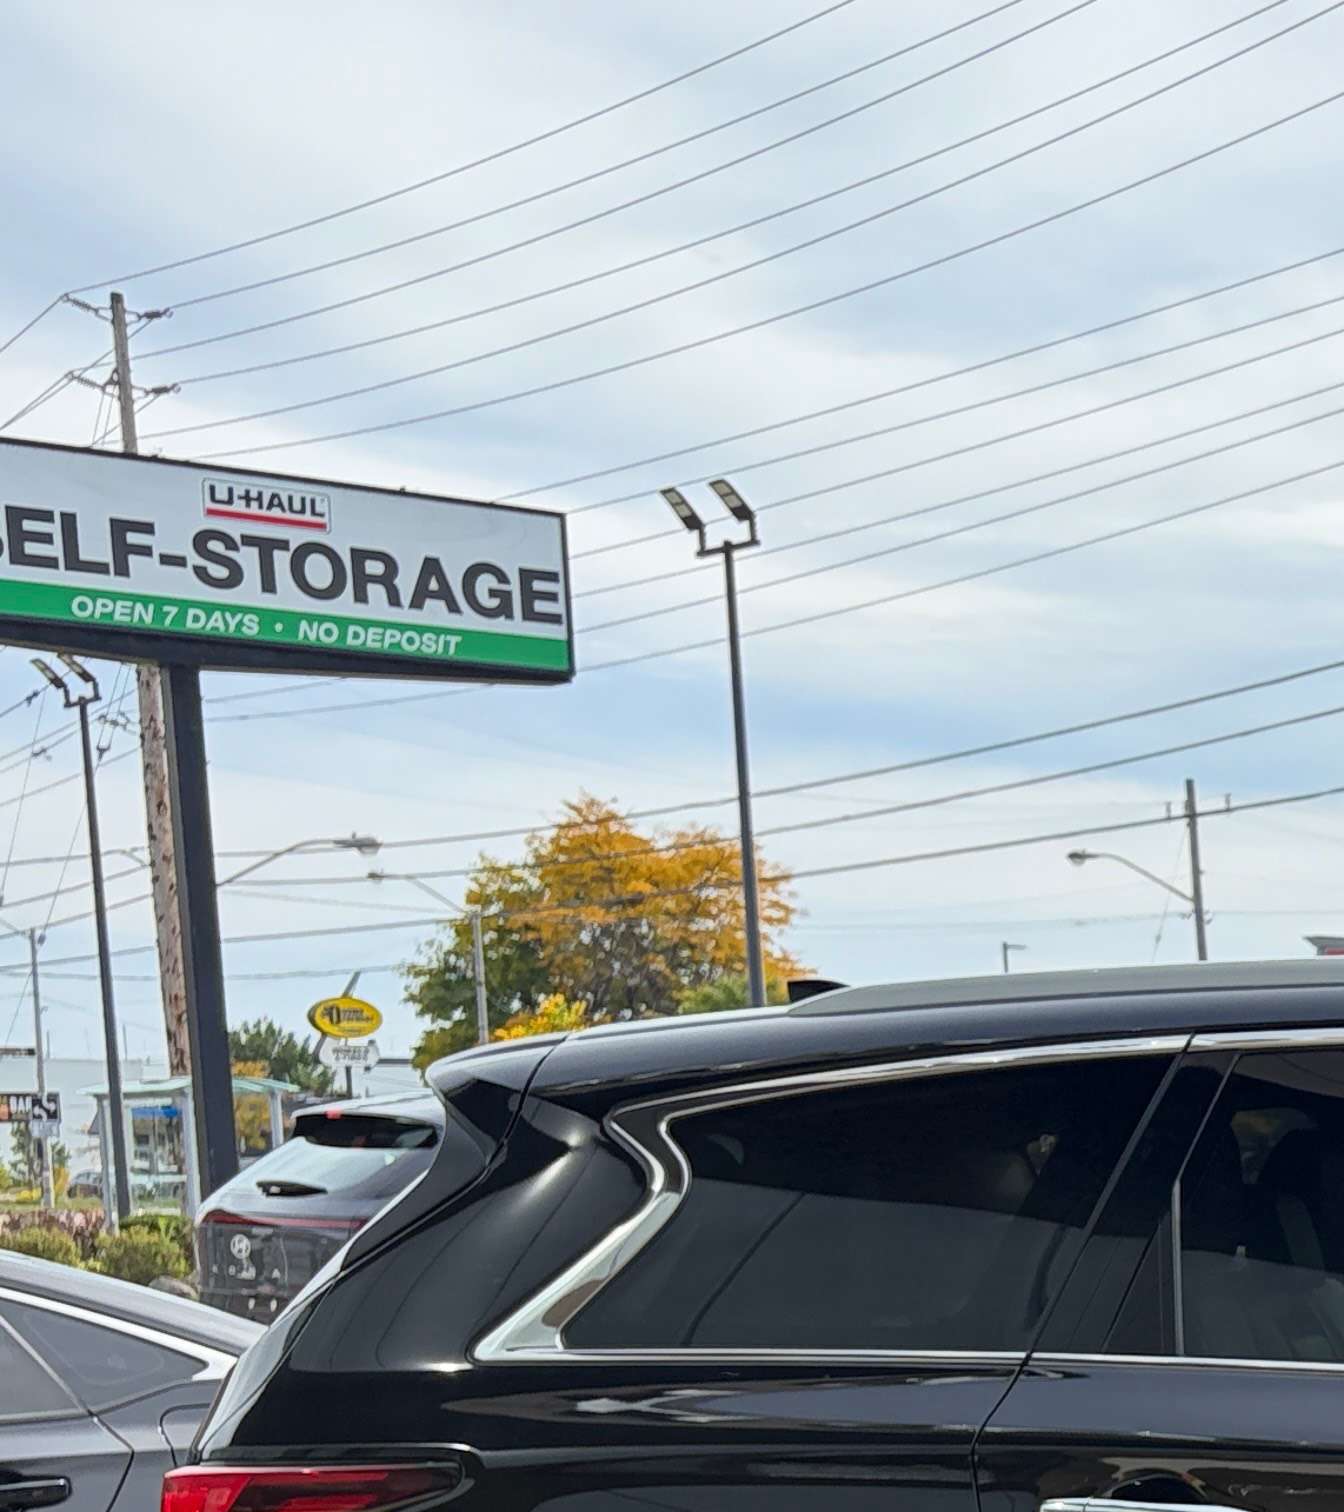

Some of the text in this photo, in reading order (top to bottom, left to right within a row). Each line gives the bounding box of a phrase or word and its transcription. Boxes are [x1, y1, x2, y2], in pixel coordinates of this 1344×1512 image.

[208, 484, 326, 518] U-HAUL
[0, 505, 564, 625] ELF-STORAGE
[71, 595, 462, 657] OPEN 7 DAYS NO DEPOSIT
